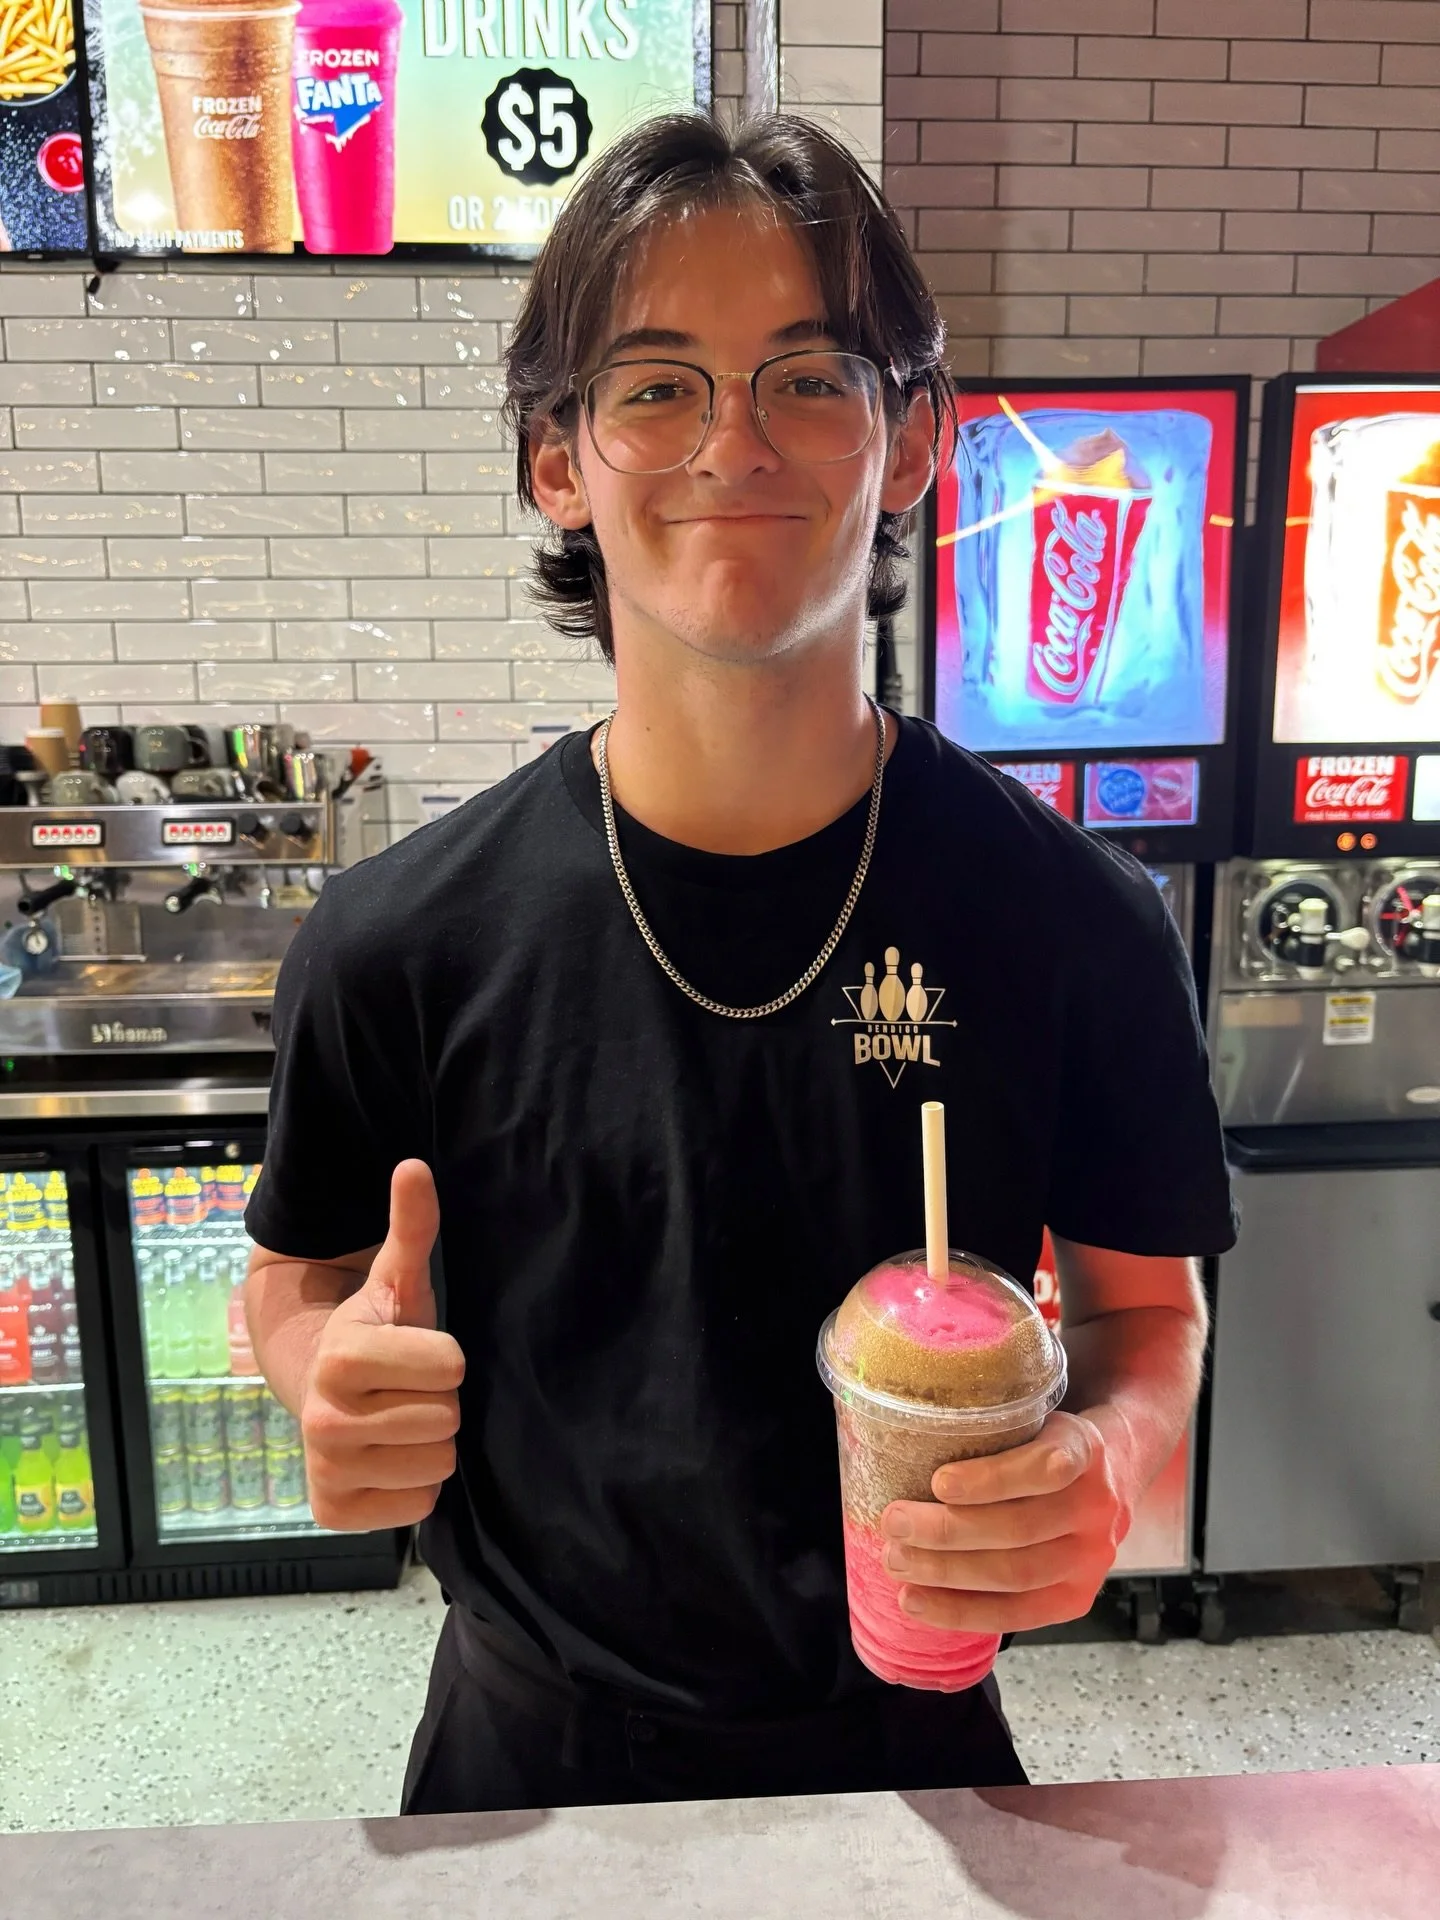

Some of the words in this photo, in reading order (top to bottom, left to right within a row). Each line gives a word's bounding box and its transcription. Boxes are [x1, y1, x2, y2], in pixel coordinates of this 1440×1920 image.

[421, 0, 640, 61] DRINKS
[297, 48, 380, 68] FROZEN
[192, 95, 263, 115] FROZEN
[297, 71, 382, 111] FANTA
[497, 83, 578, 171] $5
[448, 194, 485, 231] OR
[175, 229, 244, 249] PAYMENTS
[1033, 498, 1107, 696] Coca-Cola
[1307, 756, 1395, 778] FROZEN
[867, 1024, 919, 1034] BENDIGO
[853, 1032, 941, 1067] BOWL
